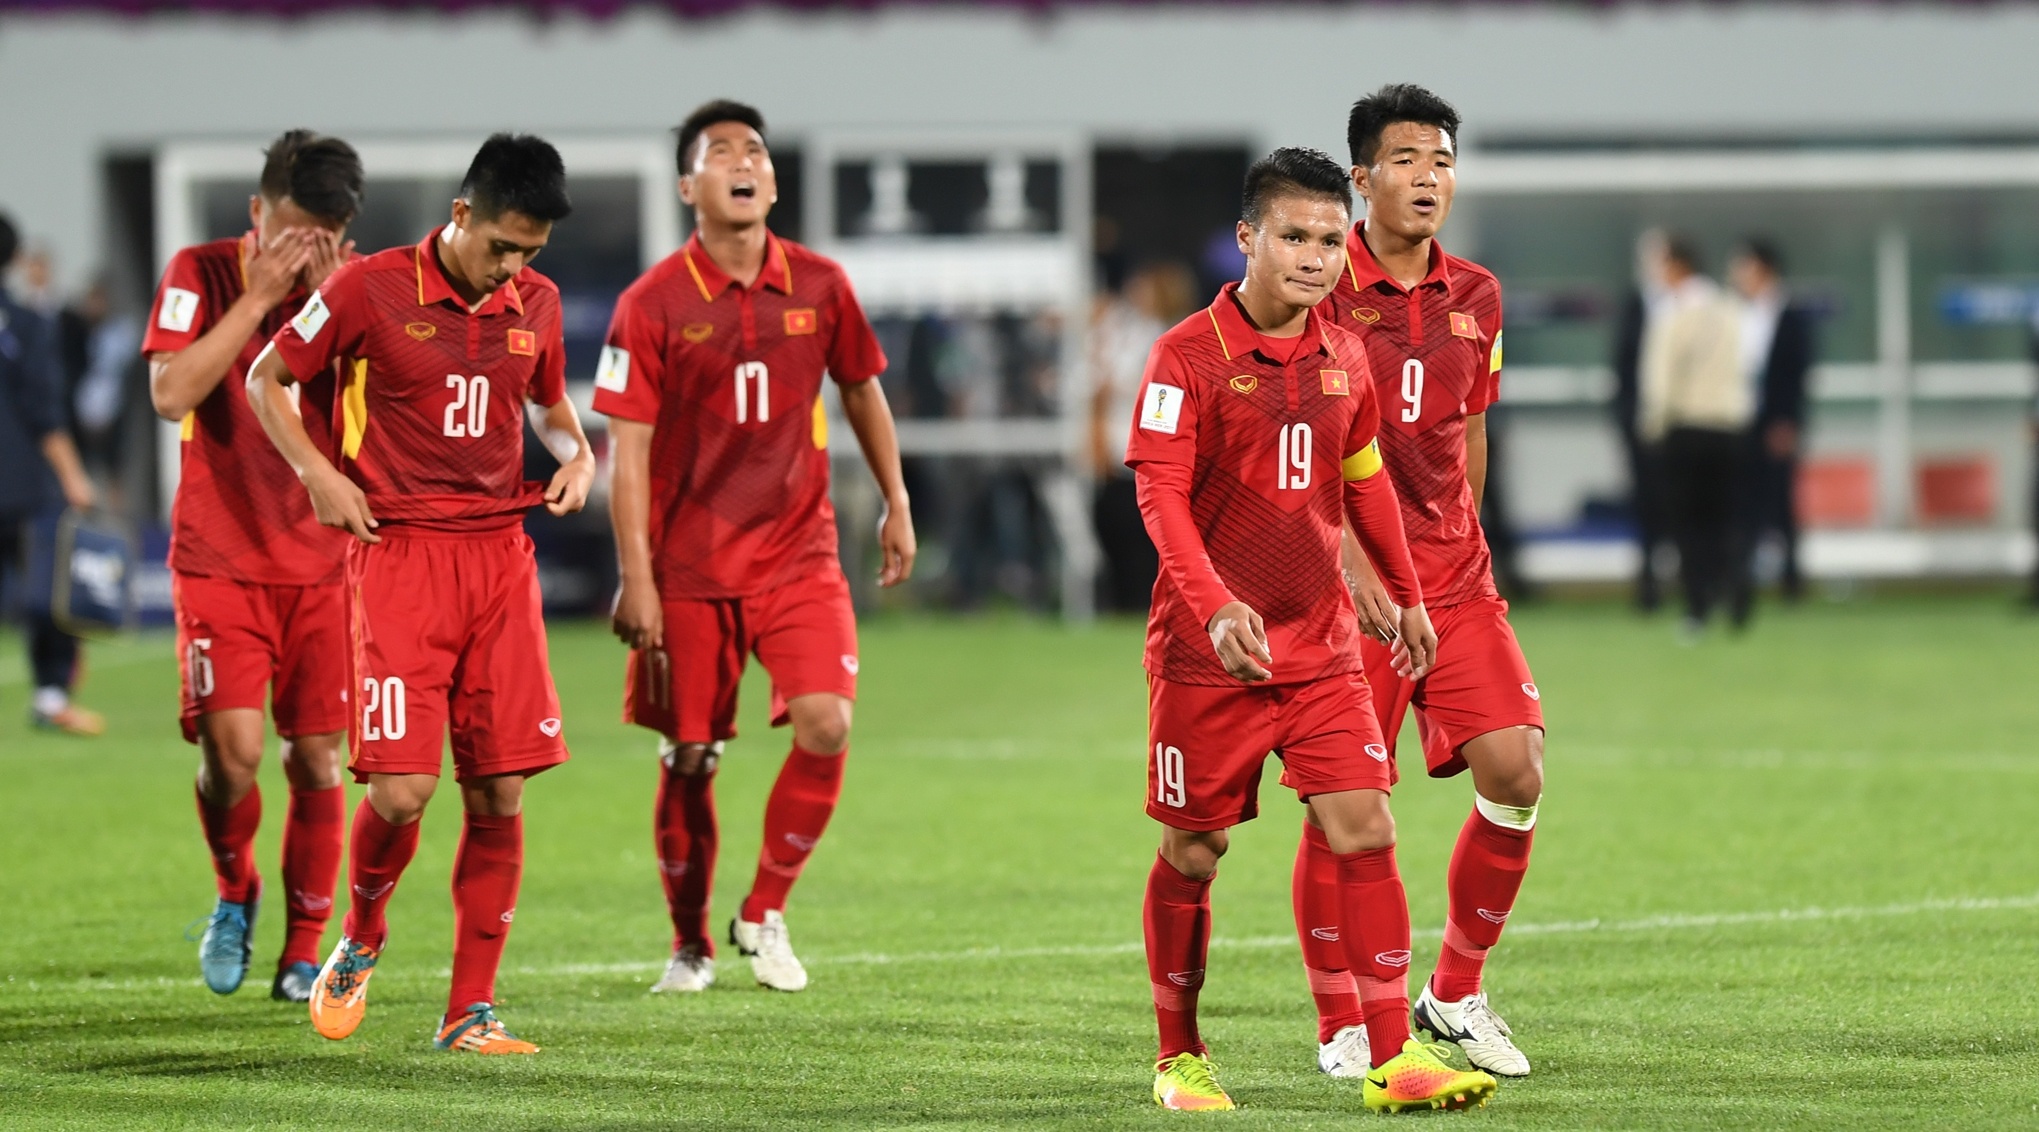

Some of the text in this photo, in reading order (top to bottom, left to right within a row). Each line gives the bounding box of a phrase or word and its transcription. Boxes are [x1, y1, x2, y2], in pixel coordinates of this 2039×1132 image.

[443, 373, 490, 438] 20
[734, 361, 770, 424] 17
[1400, 358, 1425, 423] 9
[1277, 422, 1313, 490] 19
[362, 676, 407, 741] 20
[1155, 741, 1187, 808] 19
